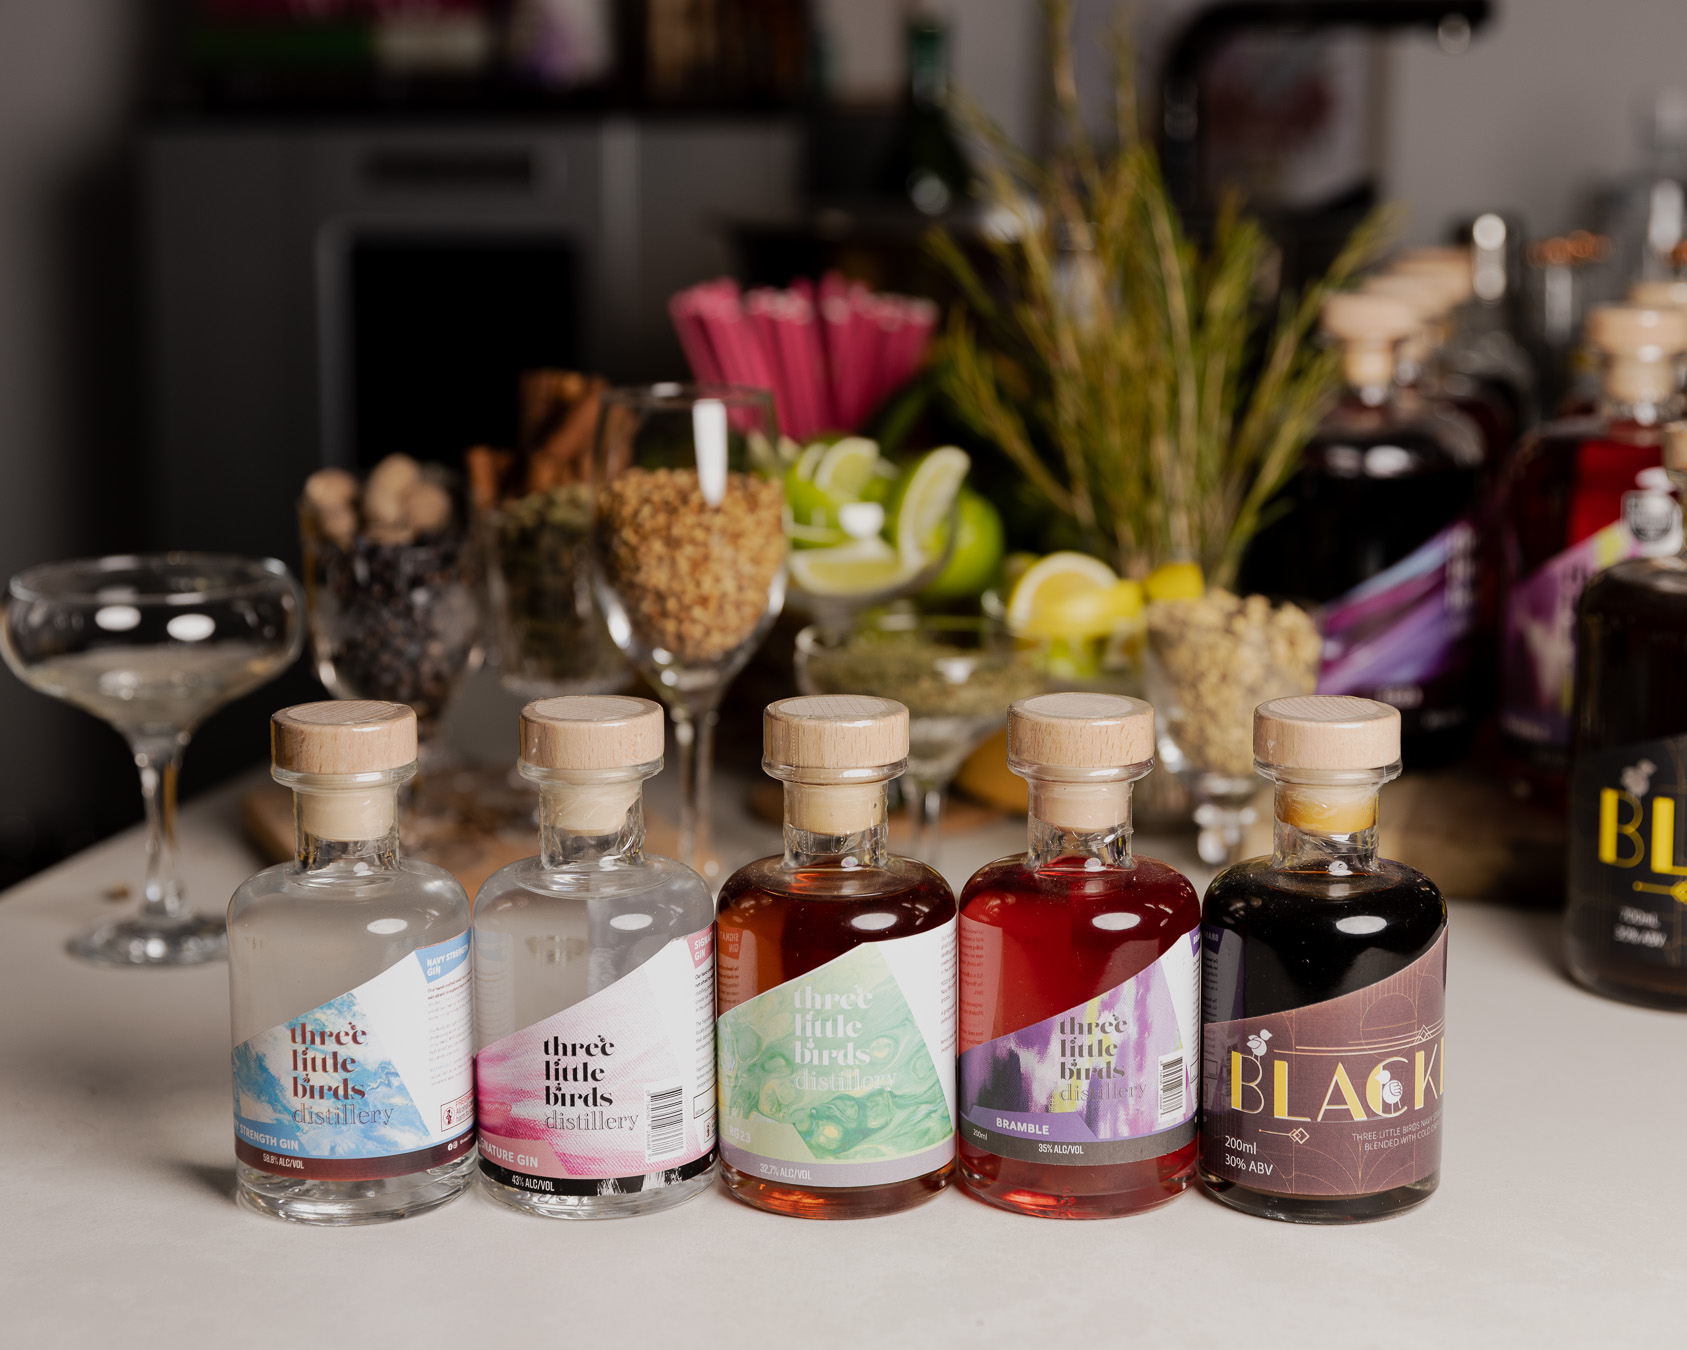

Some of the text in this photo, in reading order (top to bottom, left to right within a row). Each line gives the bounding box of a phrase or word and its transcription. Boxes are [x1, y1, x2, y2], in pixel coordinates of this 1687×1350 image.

[426, 955, 446, 968] NAVY
[694, 948, 706, 961] GIN
[427, 966, 441, 977] GIN
[794, 985, 873, 1010] three
[290, 1023, 367, 1046] three
[795, 1011, 863, 1038] little
[1059, 1014, 1128, 1036] three
[543, 1035, 615, 1057] three
[795, 1038, 871, 1066] birds
[1060, 1037, 1118, 1058] little
[292, 1047, 357, 1073] little
[545, 1058, 605, 1082] little
[1060, 1059, 1126, 1081] birds
[292, 1074, 366, 1100] birds
[794, 1068, 897, 1091] distillery
[545, 1083, 614, 1107] birds
[1060, 1082, 1147, 1101] distillery
[292, 1103, 394, 1125] distillery
[545, 1110, 639, 1131] distillery
[972, 1128, 988, 1140] 200ml
[996, 1117, 1050, 1135] BRAMBLE
[1352, 1131, 1377, 1141] THREE
[1379, 1127, 1401, 1139] LITTLE
[1402, 1121, 1420, 1134] BIRDS
[240, 1123, 277, 1147] STRENGTH
[280, 1138, 299, 1152] GIN
[1224, 1135, 1257, 1155] 200ml
[1364, 1138, 1400, 1151] BLENDED
[1400, 1134, 1416, 1145] WITH
[1038, 1143, 1084, 1155] 35% ALC/VOL
[279, 1157, 305, 1170] ALC/VOL
[517, 1154, 539, 1168] GIN
[759, 1163, 812, 1180] 32.7% ALC/VOL
[1224, 1153, 1273, 1176] 30% ABV
[511, 1174, 555, 1192] 43% ALC/VOL
